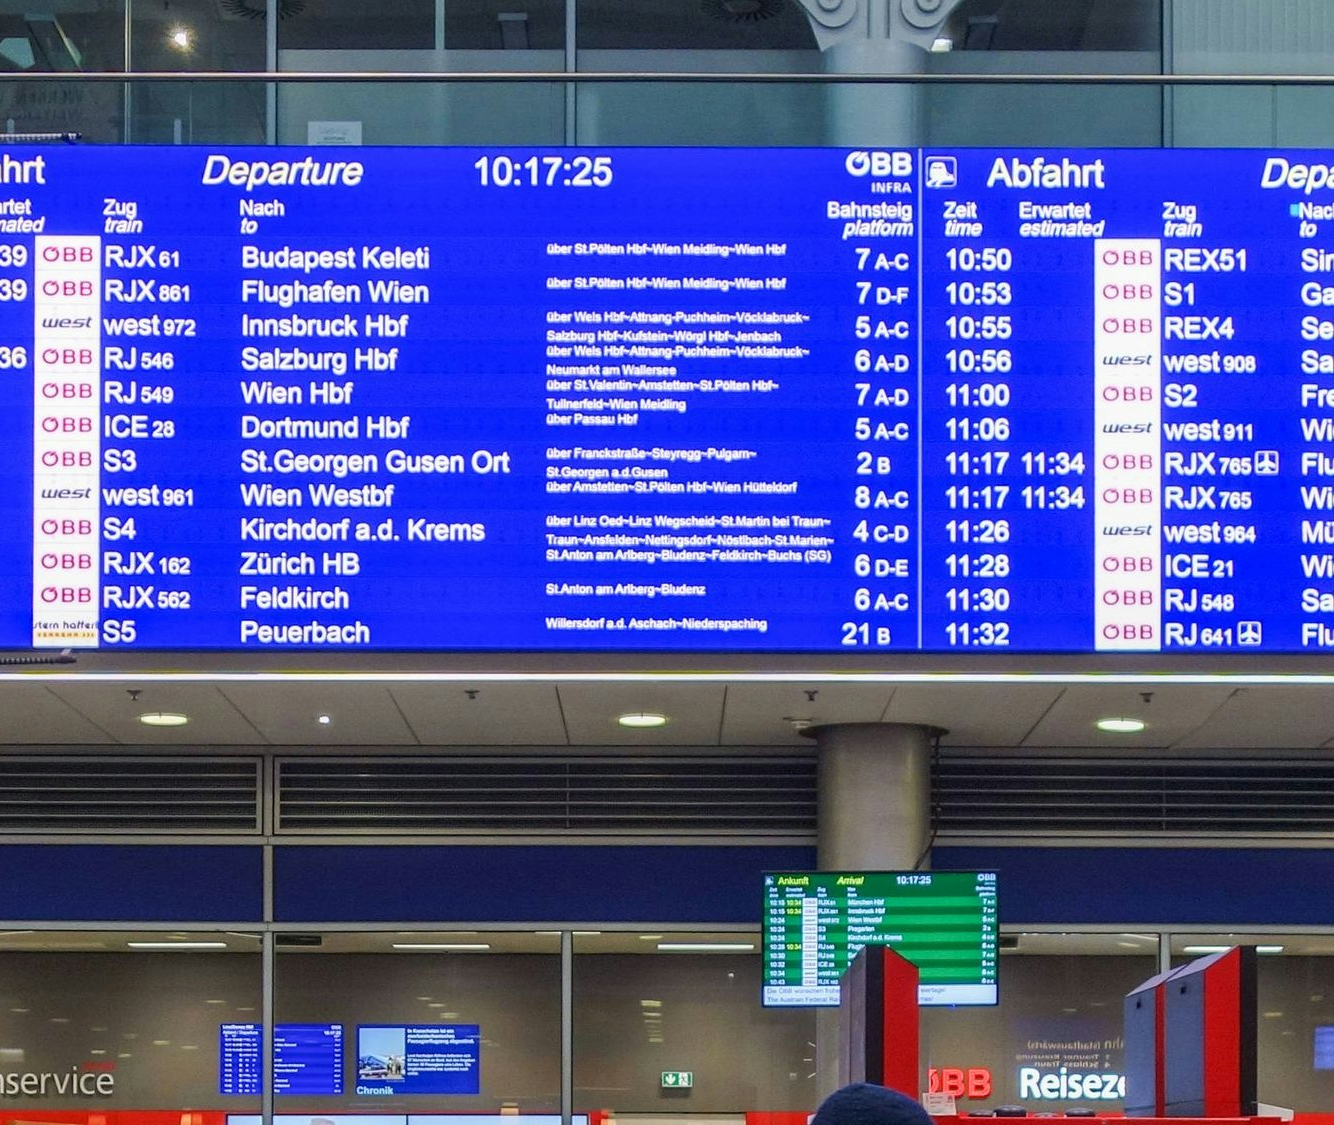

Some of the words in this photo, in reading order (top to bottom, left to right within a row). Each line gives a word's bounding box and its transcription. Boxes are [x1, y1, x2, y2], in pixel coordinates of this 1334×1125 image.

[203, 156, 363, 191] Departure
[475, 157, 613, 187] 10:17:25
[846, 152, 912, 177] ÖBB
[987, 157, 1104, 188] Abfahrt
[872, 182, 912, 194] INFRA
[103, 199, 137, 219] Zug
[240, 200, 285, 217] Nach
[827, 200, 913, 221] Bahnsteig
[104, 216, 144, 234] train
[241, 218, 259, 234] to
[842, 218, 914, 240] platform
[105, 246, 155, 269] RJX
[159, 251, 179, 268] 61
[243, 246, 357, 273] Budapest
[363, 247, 429, 269] Keleti
[546, 243, 572, 255] über
[574, 243, 624, 255] St.Pölten
[765, 243, 787, 255] Hbf
[856, 248, 871, 271] 7
[875, 253, 909, 271] A-C
[1165, 249, 1246, 272] REX51
[243, 280, 360, 307] Flughafen
[368, 281, 429, 303] Wien
[1165, 282, 1195, 305] S1
[104, 315, 160, 336] west
[164, 319, 196, 336] 972
[243, 314, 358, 337] Innsbruck
[366, 315, 409, 337] Hbf
[242, 347, 347, 375] Salzburg
[355, 348, 399, 370] Hbf
[546, 364, 600, 376] Neumarkt
[602, 366, 620, 376] am
[622, 364, 676, 376] Wallersee
[241, 382, 303, 404] Wien
[311, 382, 354, 404] Hbf
[105, 415, 149, 438] ICE
[153, 421, 175, 438] 28
[242, 416, 358, 439] Dortmund
[367, 416, 410, 438] Hbf
[546, 414, 572, 426] über
[574, 414, 615, 426] Passau
[617, 414, 639, 426] Hbf
[241, 449, 377, 477] St.Georgen
[386, 450, 464, 473] Gusen
[472, 450, 510, 473] Ort
[546, 467, 609, 480] St.Georgen
[241, 484, 302, 506] Wien
[309, 484, 394, 506] Westbf
[242, 518, 350, 541] Kirchdorf
[357, 518, 400, 541] a.d.
[408, 519, 485, 541] Krems
[240, 551, 315, 575] Zürich
[323, 553, 360, 575] HB
[241, 586, 349, 609] Feldkirch
[241, 621, 370, 643] Peuerbach
[842, 623, 869, 645] 21
[878, 628, 891, 645] B
[778, 876, 809, 885] Ankunft
[836, 876, 865, 885] Arrival
[896, 876, 932, 886] 10:17:25
[356, 1086, 394, 1095] Chronik
